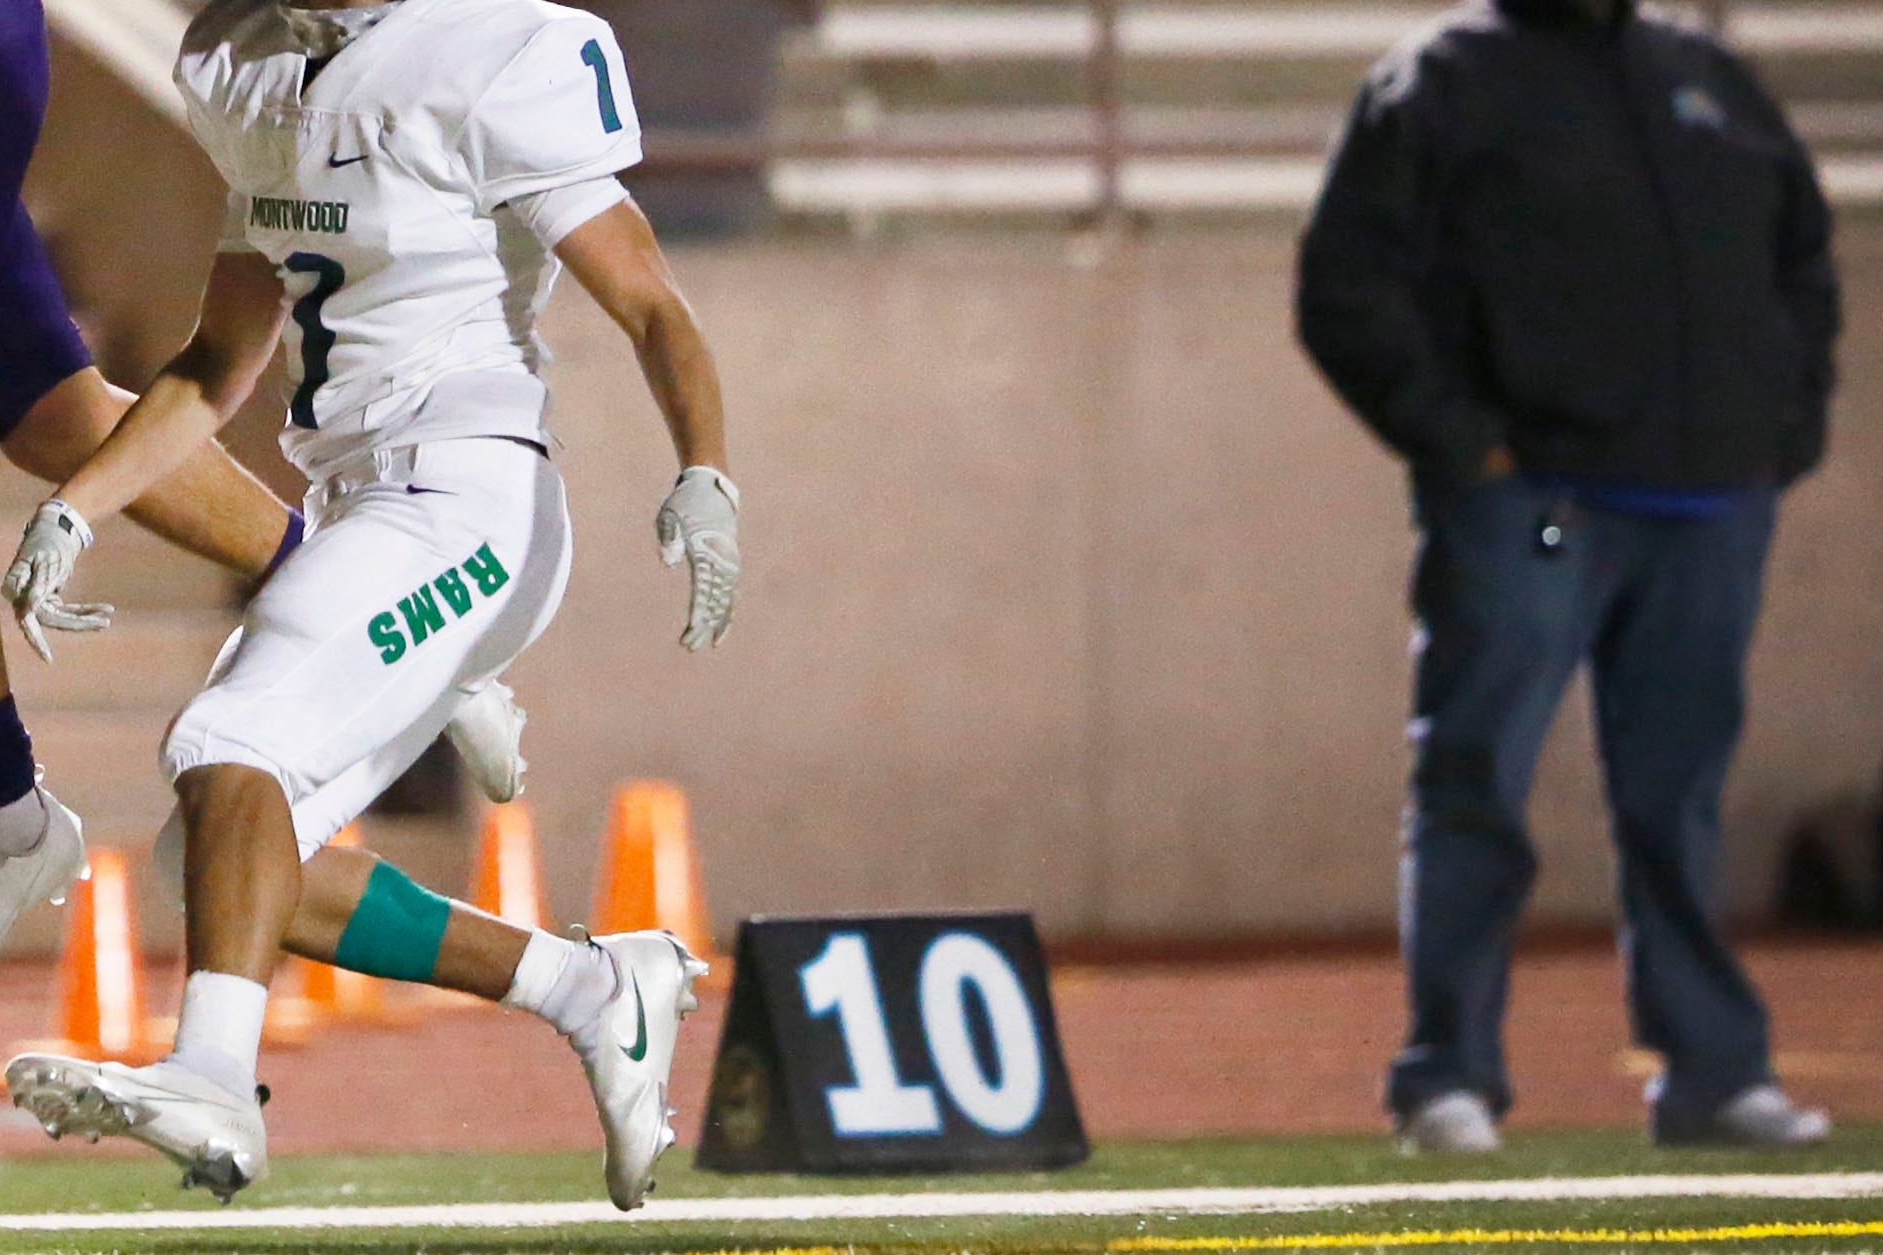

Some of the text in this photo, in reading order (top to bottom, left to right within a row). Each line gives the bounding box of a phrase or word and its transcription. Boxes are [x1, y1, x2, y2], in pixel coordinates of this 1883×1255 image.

[580, 39, 623, 134] 1
[250, 196, 349, 234] MONTWOOD
[367, 541, 510, 665] RAMS
[800, 932, 1044, 1136] 10
